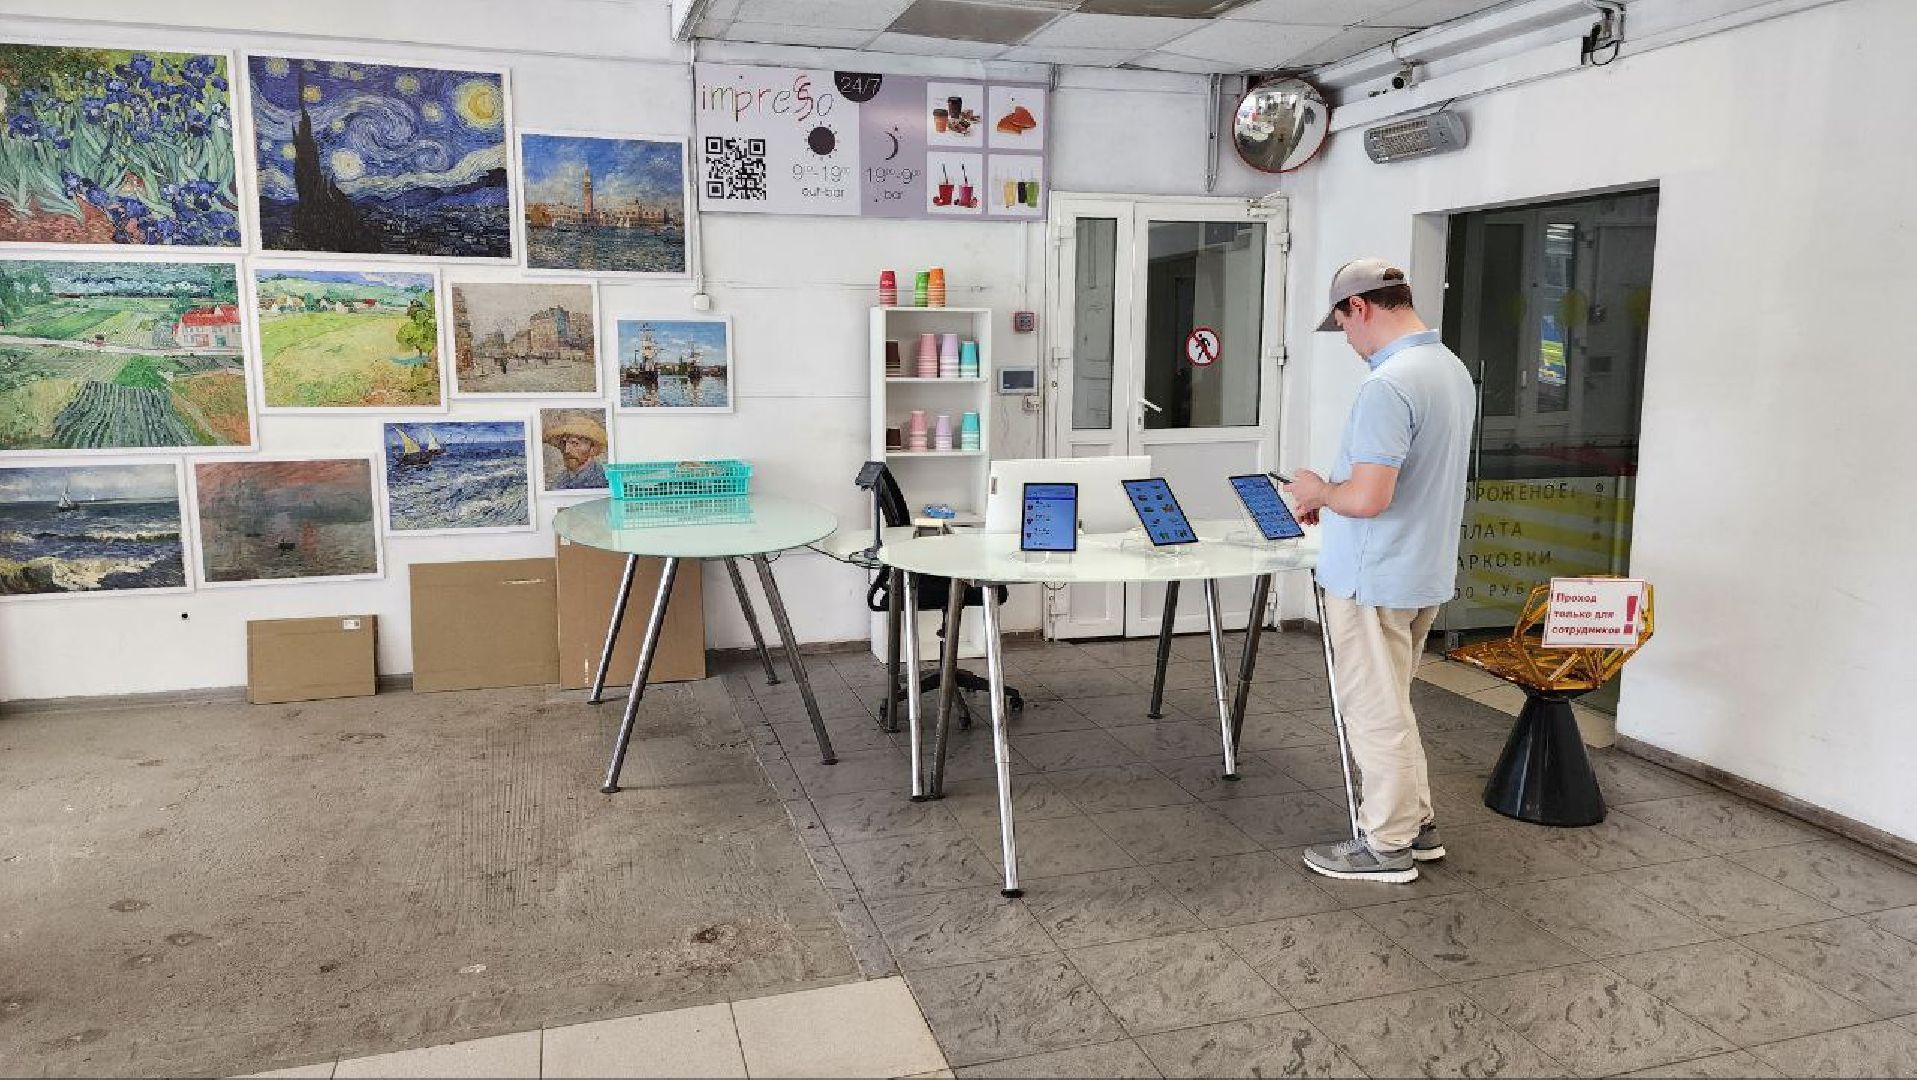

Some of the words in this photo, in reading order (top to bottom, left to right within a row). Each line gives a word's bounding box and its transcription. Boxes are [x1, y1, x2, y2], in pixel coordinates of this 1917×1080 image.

[840, 76, 881, 95] 24/7
[884, 189, 904, 200] bar
[1556, 593, 1597, 604] Проход
[1554, 611, 1592, 619] только
[1595, 611, 1615, 620] для
[1552, 626, 1621, 636] сотрудников
